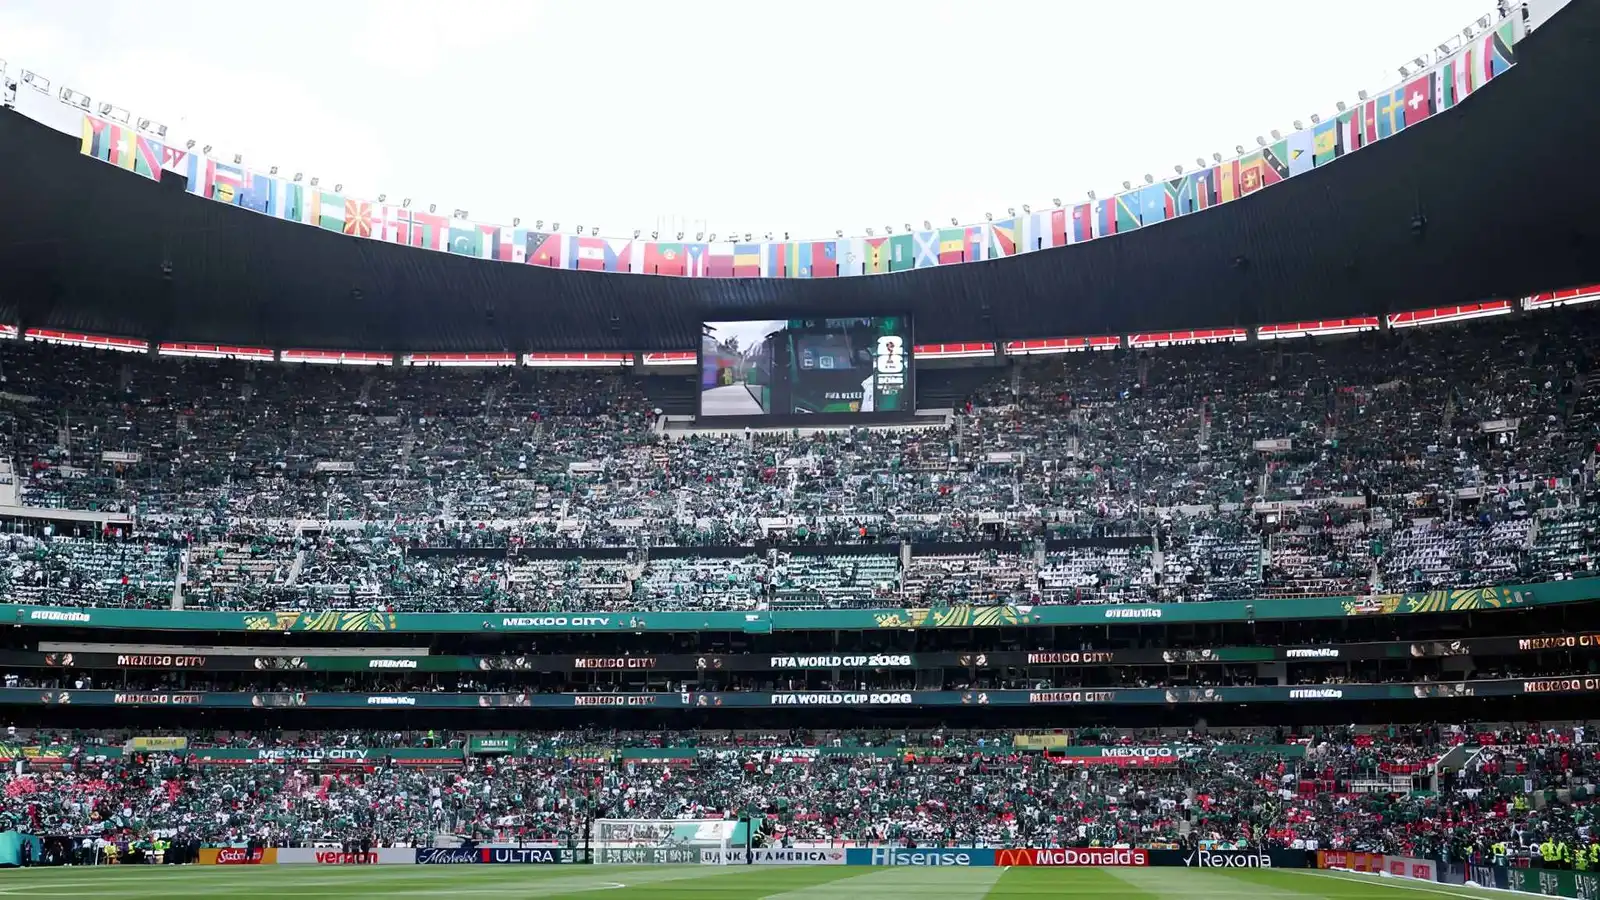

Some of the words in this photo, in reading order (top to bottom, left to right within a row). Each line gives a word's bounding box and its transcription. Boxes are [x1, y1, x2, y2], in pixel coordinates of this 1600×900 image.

[503, 618, 567, 626] MEXICO
[572, 618, 609, 626] CITY
[1519, 637, 1575, 650] MEXICO
[175, 656, 205, 666] CITY
[575, 658, 624, 668] MEXICO
[628, 658, 657, 668] CITY
[771, 657, 797, 667] FIFA
[797, 656, 841, 667] WORLD
[843, 656, 867, 666] CUP
[868, 655, 911, 666] 2026
[1028, 653, 1079, 664] MEXICO
[1083, 653, 1114, 663] CITY
[771, 694, 797, 704] FIFA
[797, 694, 842, 704] WORLD
[843, 694, 868, 704] CUP
[869, 694, 912, 703] 2026
[329, 749, 369, 759] CITY
[1101, 747, 1171, 757] MEXICO
[496, 850, 554, 863] ULTRA
[764, 851, 827, 861] AMERICA
[871, 848, 970, 866] Hisense
[1036, 849, 1145, 865] McDonald's
[1199, 850, 1271, 868] Rexona
